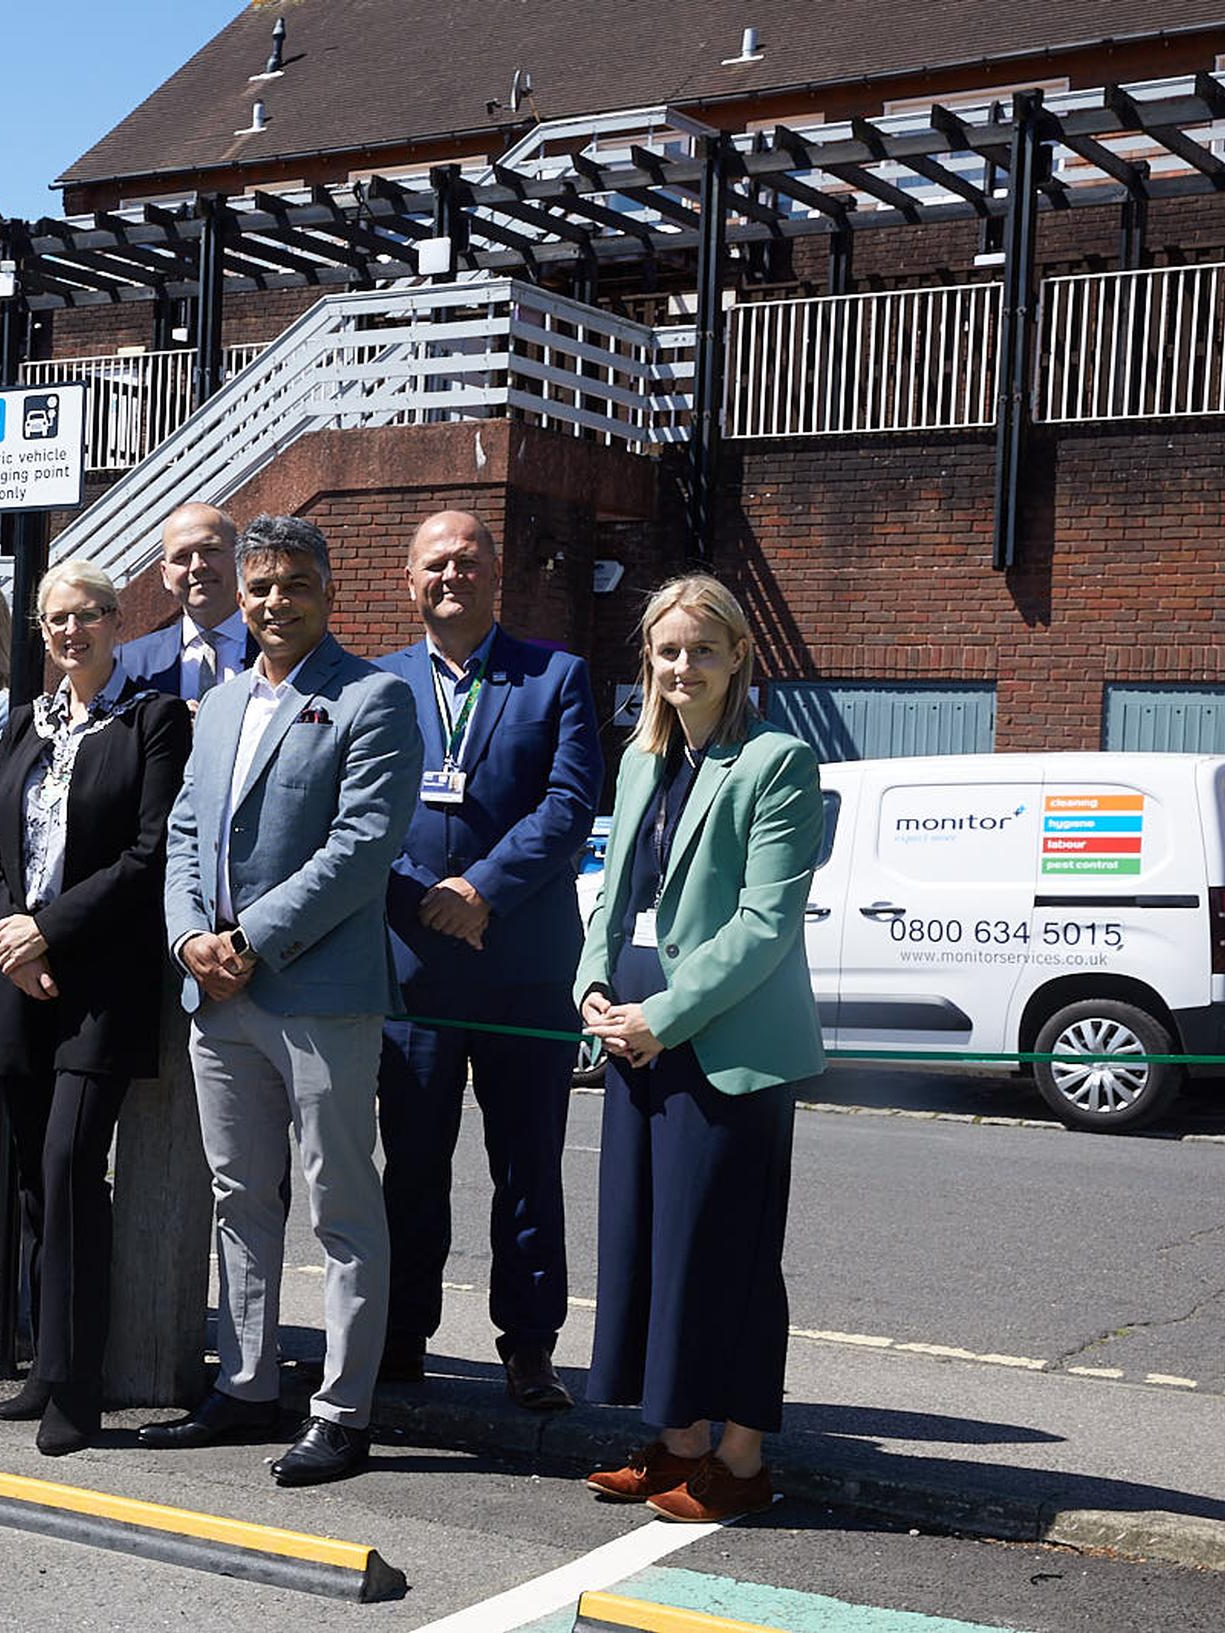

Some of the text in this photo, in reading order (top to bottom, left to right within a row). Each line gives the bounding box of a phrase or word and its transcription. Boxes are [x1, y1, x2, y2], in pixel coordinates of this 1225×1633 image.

[19, 448, 67, 463] vehicle
[34, 466, 70, 481] point
[1049, 797, 1098, 808] cleaning
[896, 814, 1013, 831] monitor
[1047, 818, 1096, 829] hygiene
[1046, 839, 1087, 850] labour
[1045, 860, 1119, 871] pest control
[890, 919, 1122, 946] 0800 634 5015
[900, 950, 1108, 967] www.monitorservices.co.uk
